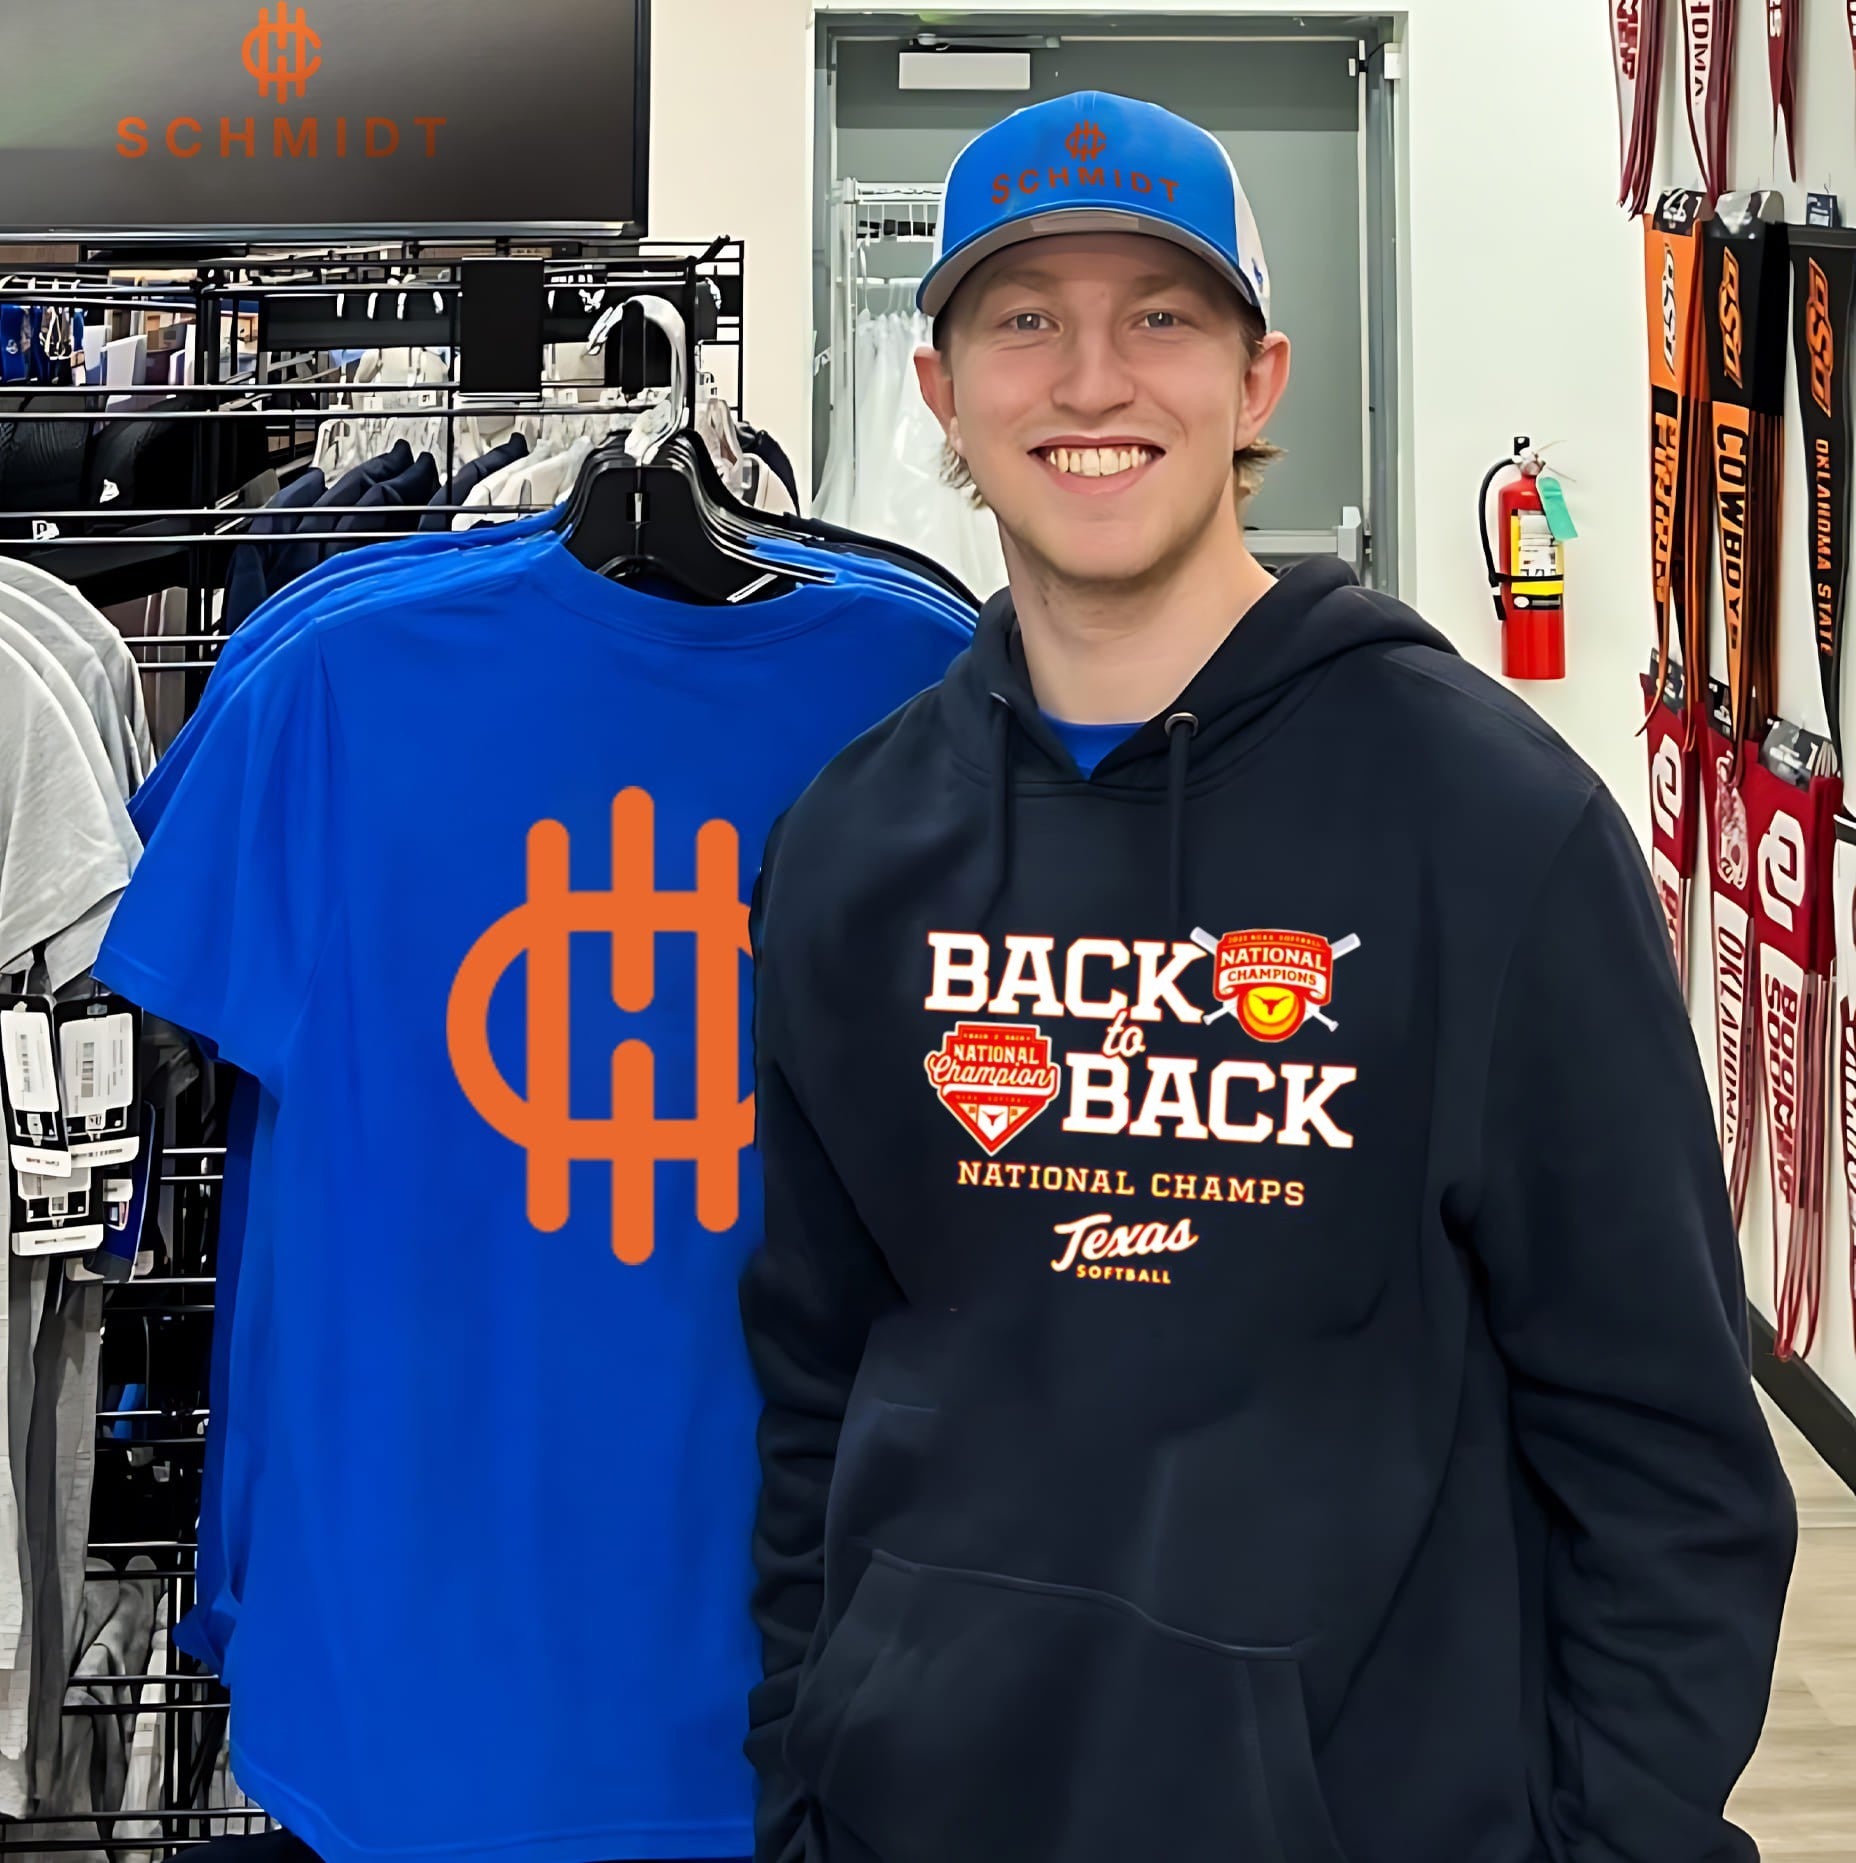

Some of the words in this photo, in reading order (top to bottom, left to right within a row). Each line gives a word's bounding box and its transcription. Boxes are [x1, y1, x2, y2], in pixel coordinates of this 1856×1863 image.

[115, 116, 448, 159] SCHMIDT
[991, 167, 1179, 204] SCHMIDT
[924, 931, 1207, 1024] BACK
[1220, 946, 1327, 972] NATIONAL
[1227, 968, 1317, 986] CHAMPIONS
[954, 1043, 1039, 1065] NATIONAL
[1102, 1008, 1146, 1058] to
[1062, 1052, 1357, 1149] BACK
[957, 1161, 1135, 1196] NATIONAL
[1151, 1173, 1305, 1206] CHAMPS
[1051, 1213, 1199, 1272] Texas
[1076, 1264, 1171, 1285] SOFTBALL
